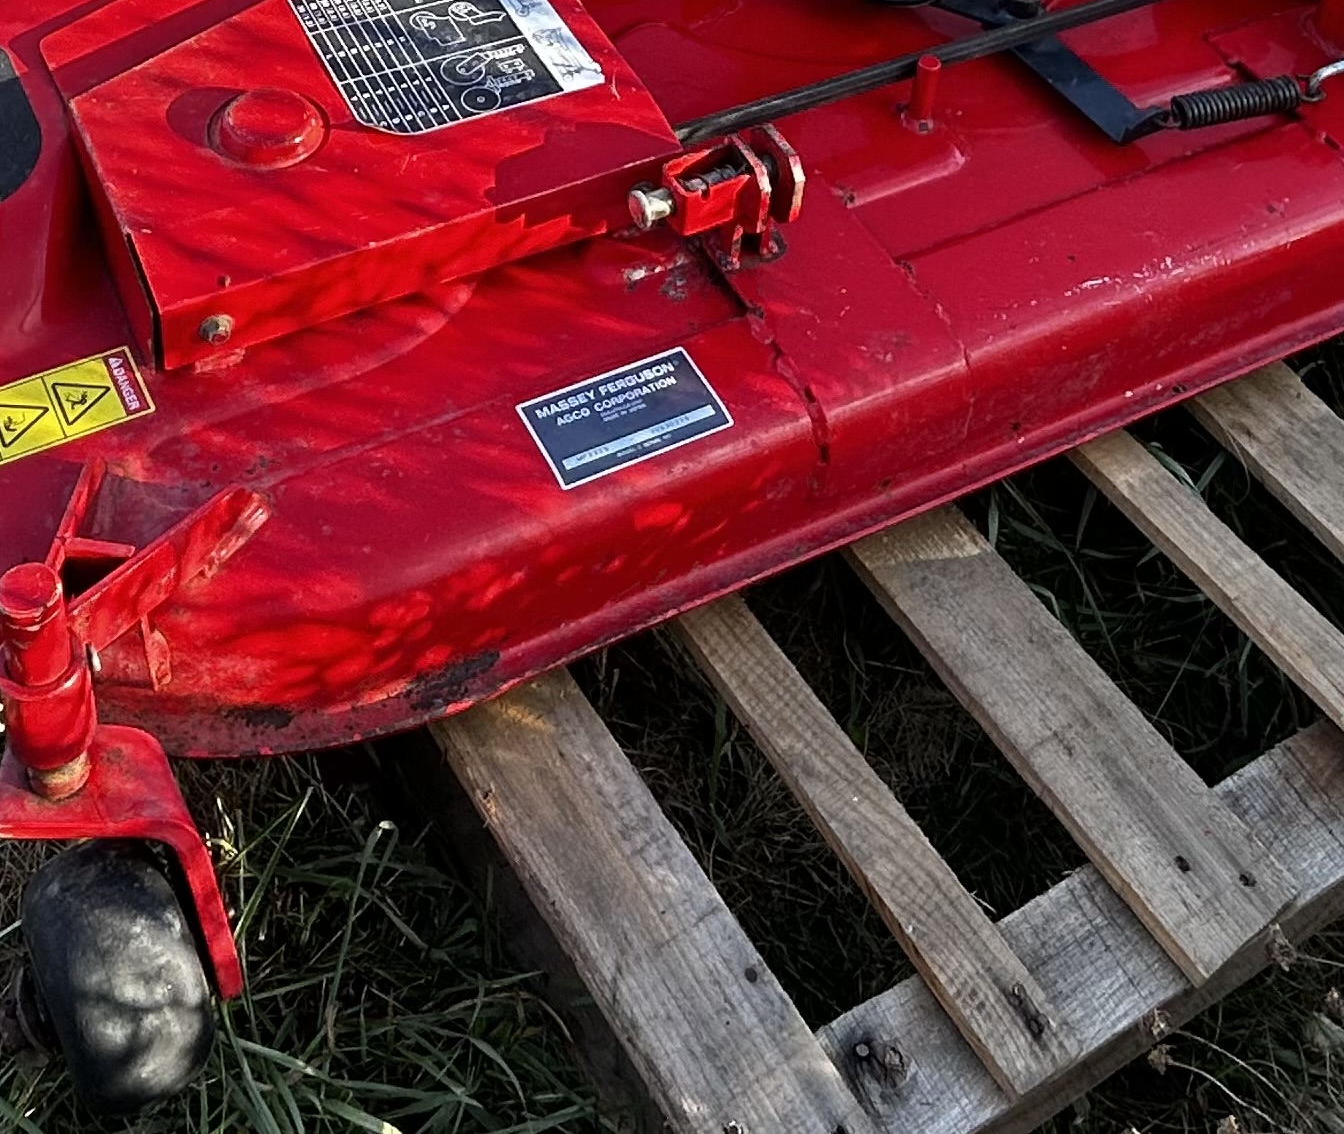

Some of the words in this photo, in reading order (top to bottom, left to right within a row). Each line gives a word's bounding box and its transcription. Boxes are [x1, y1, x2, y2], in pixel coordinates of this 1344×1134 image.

[112, 367, 140, 411] DANGER
[535, 389, 596, 419] MASSEY
[598, 361, 676, 397] FERGUSON
[556, 407, 591, 426] AGCO
[593, 375, 677, 412] CORPORATION
